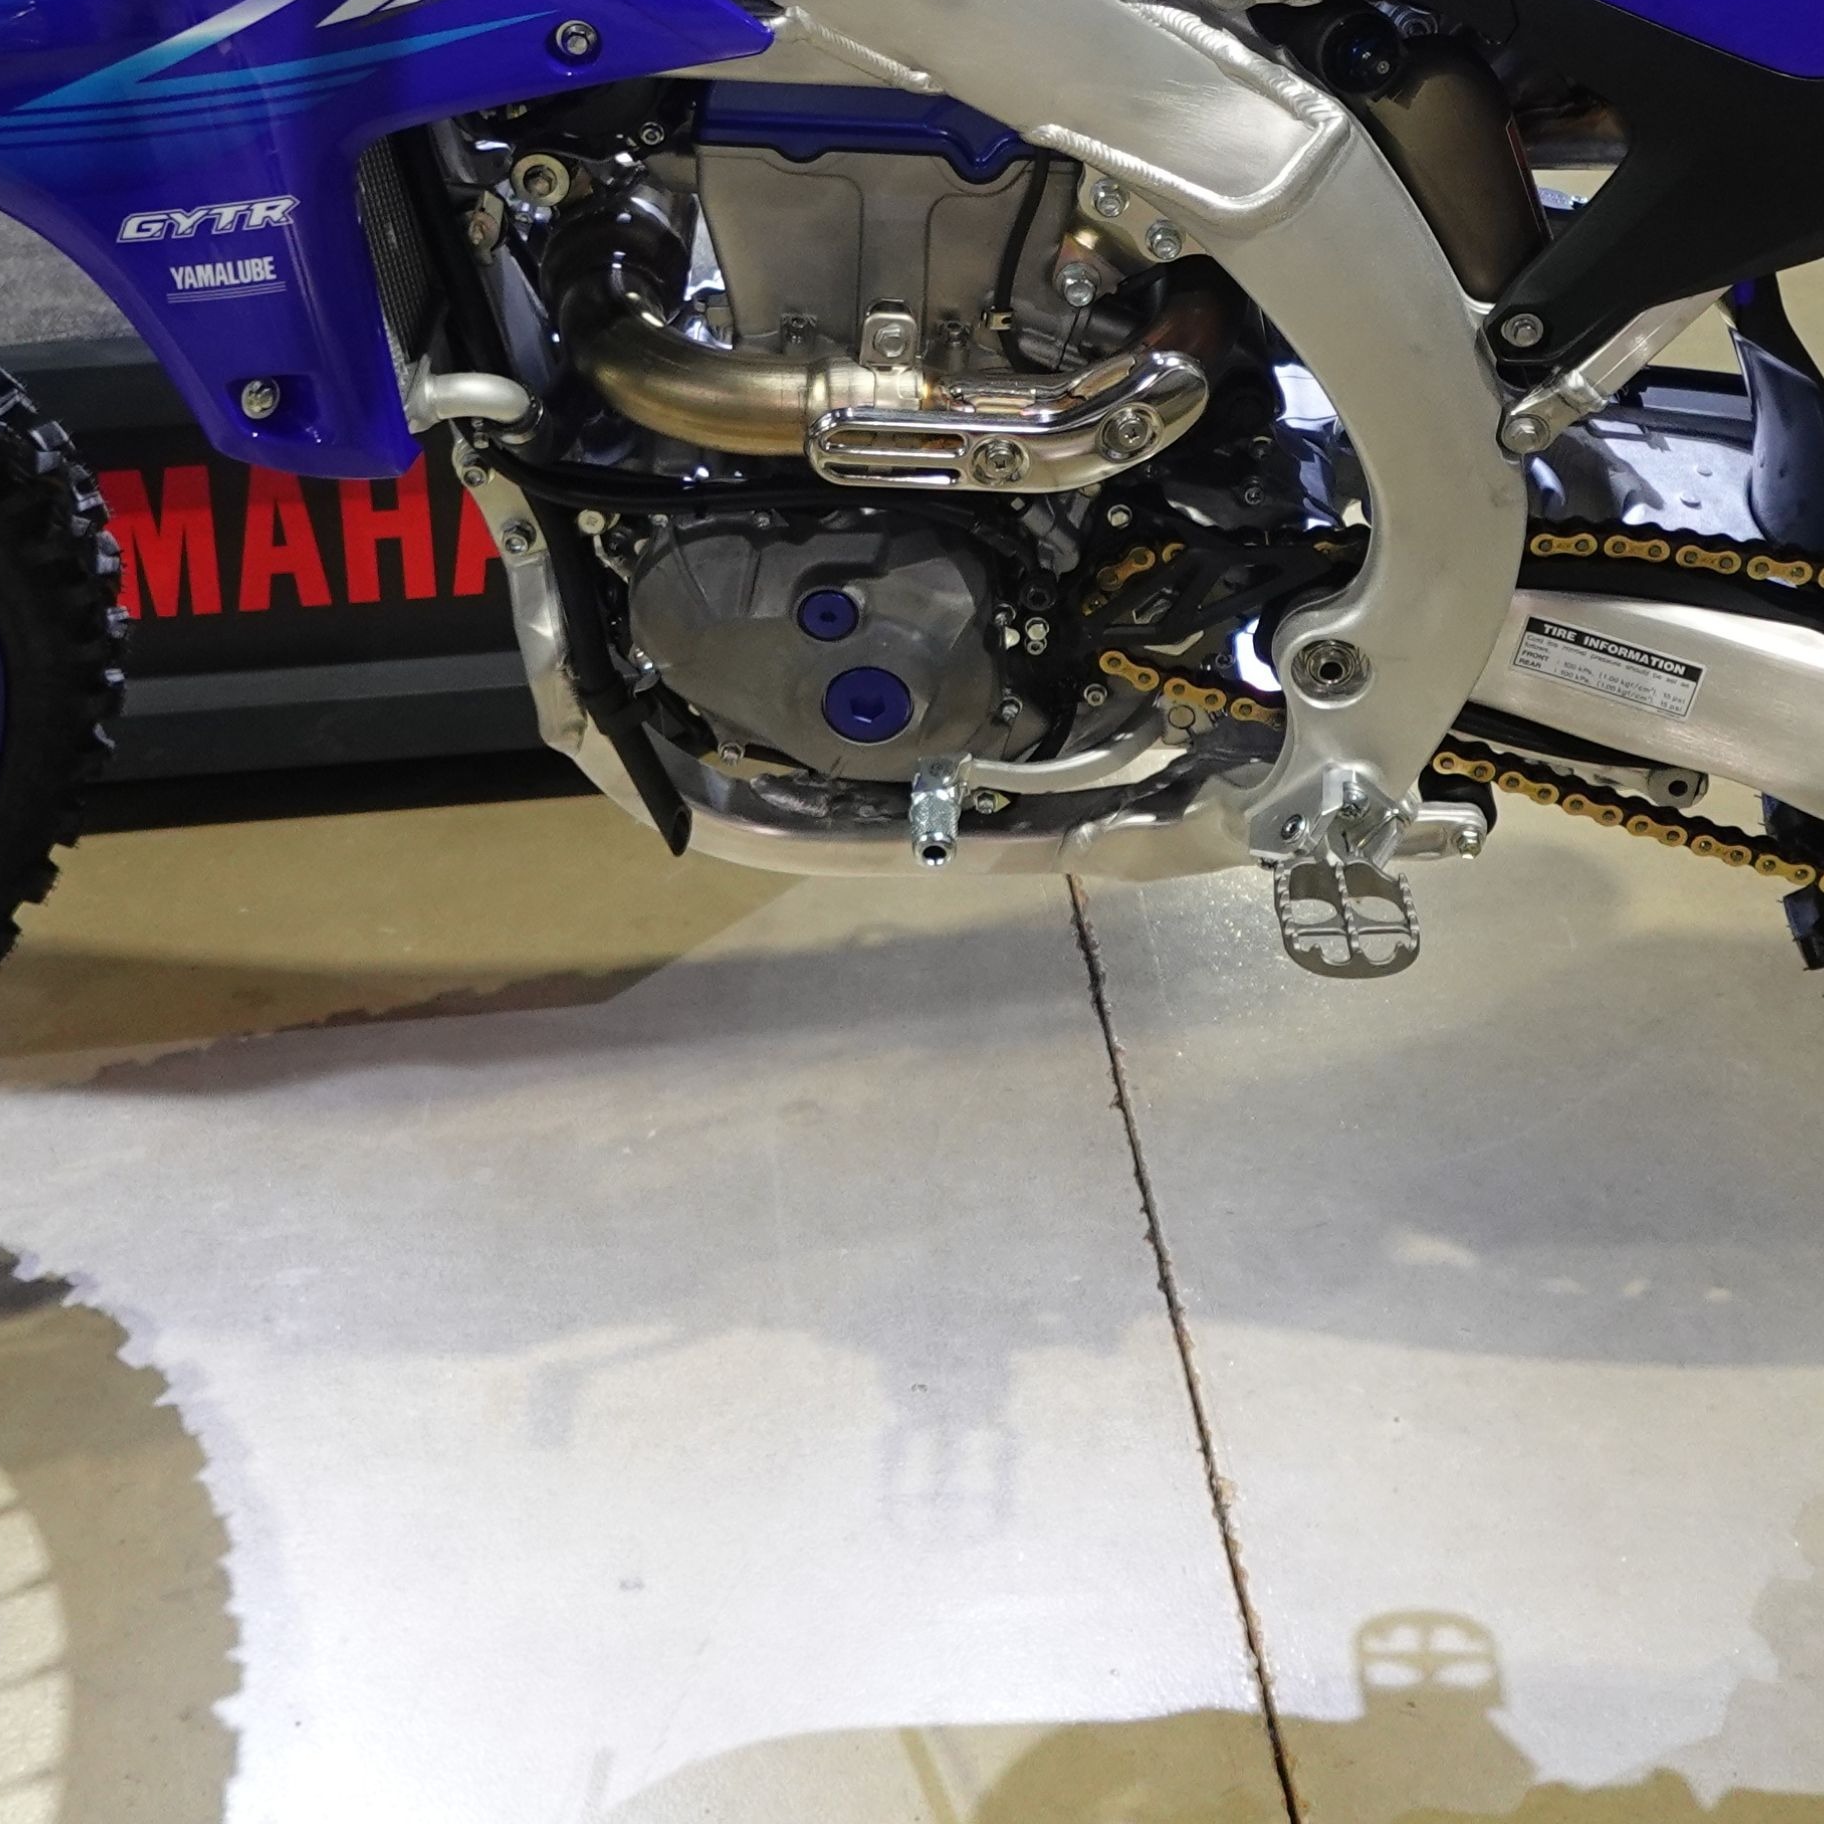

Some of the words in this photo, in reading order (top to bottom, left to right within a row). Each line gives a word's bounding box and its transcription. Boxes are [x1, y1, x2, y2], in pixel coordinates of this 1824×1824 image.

[116, 195, 301, 243] GYTR
[169, 256, 277, 290] YAMALUBE
[1518, 656, 1542, 669] REAR
[1520, 648, 1549, 662] FRONT
[1543, 623, 1578, 642] TIRE
[1583, 635, 1687, 676] INFORMATION
